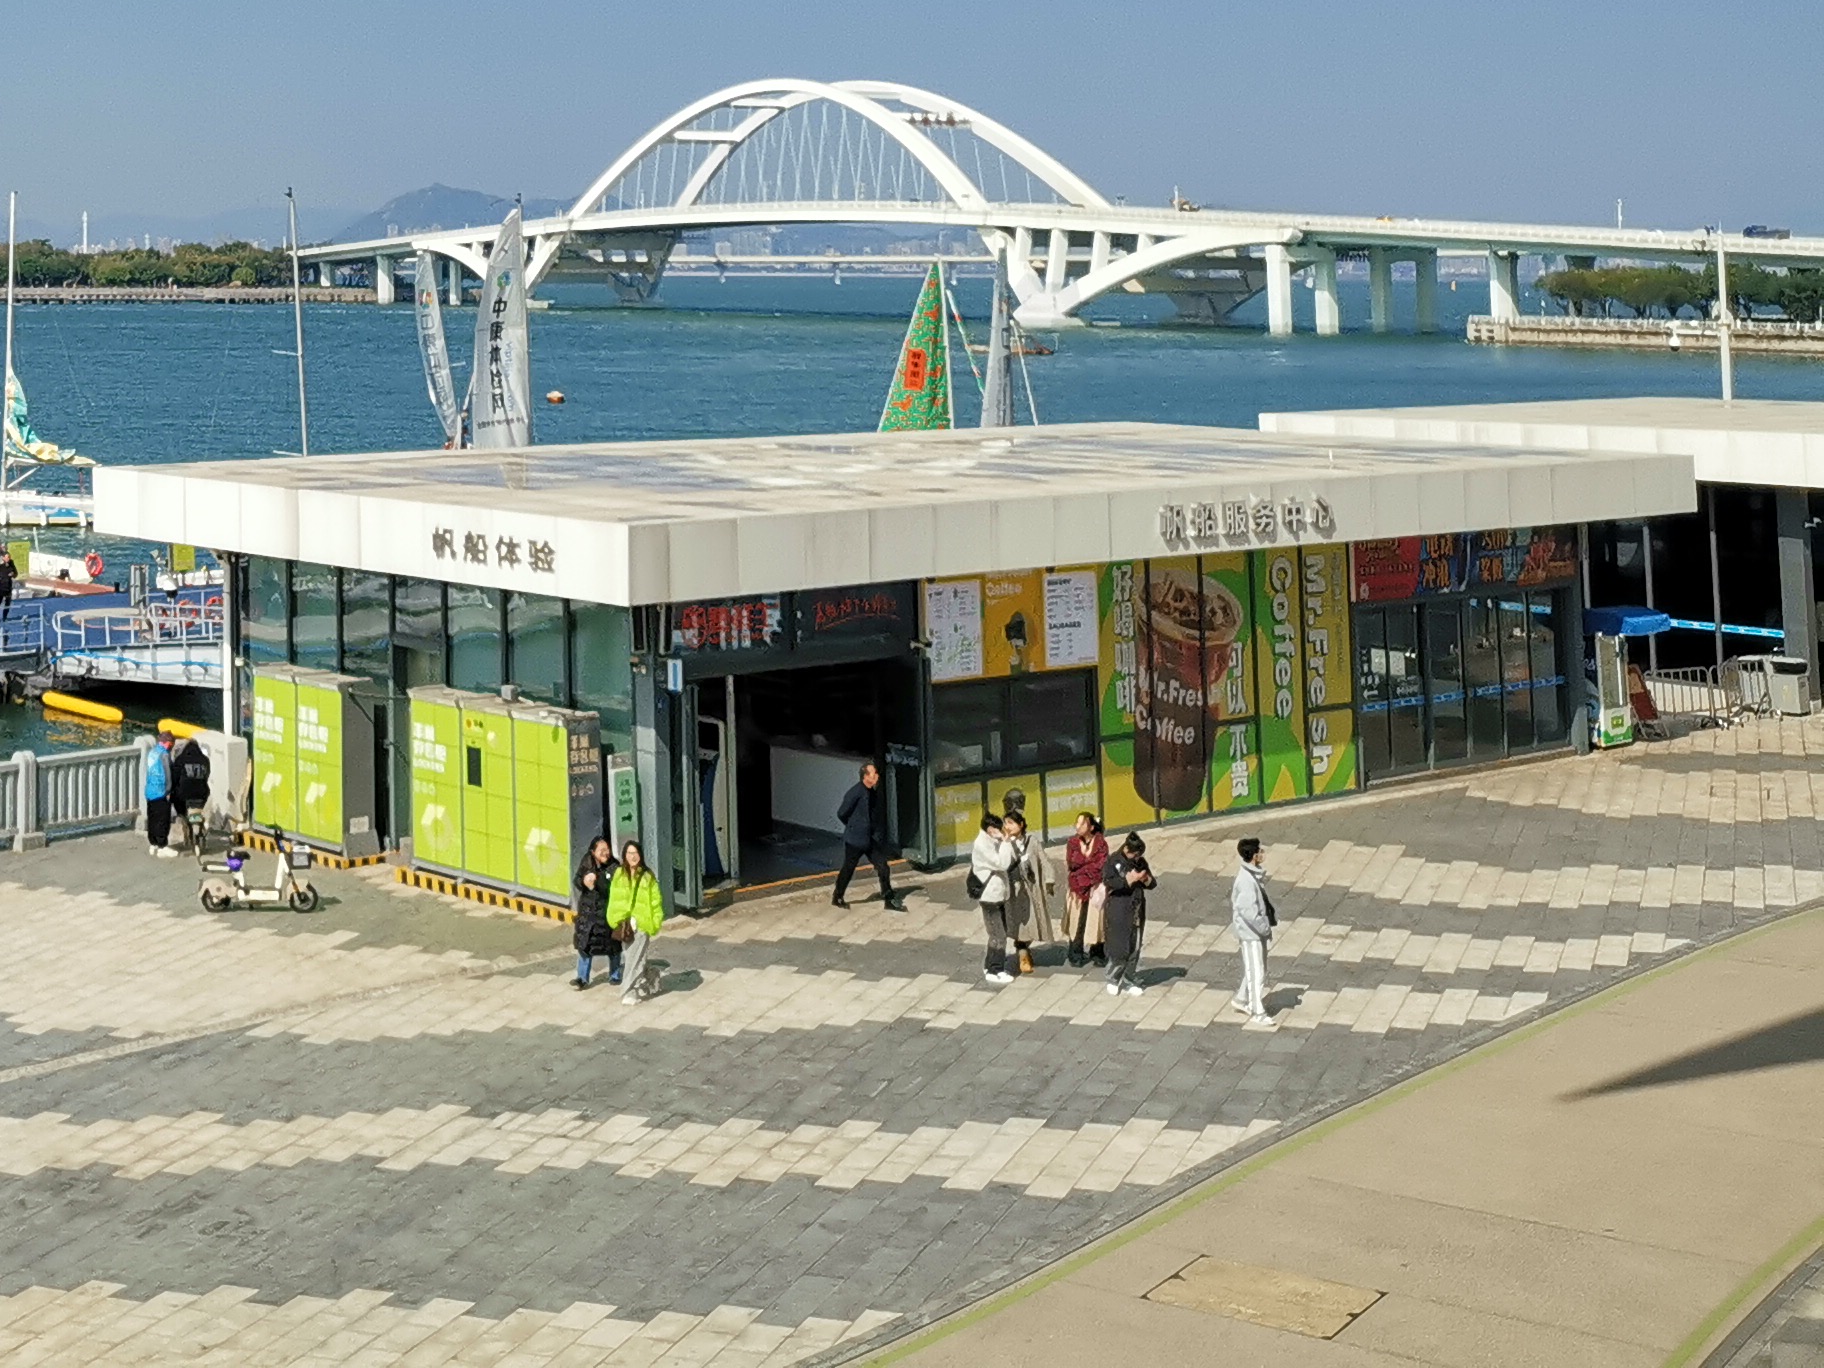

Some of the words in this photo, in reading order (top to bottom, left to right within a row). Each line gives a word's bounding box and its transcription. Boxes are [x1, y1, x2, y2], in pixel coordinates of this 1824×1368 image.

[1160, 494, 1333, 542] 帆船服务中心
[432, 524, 556, 573] 帆船体验
[1271, 556, 1295, 720] Coffee
